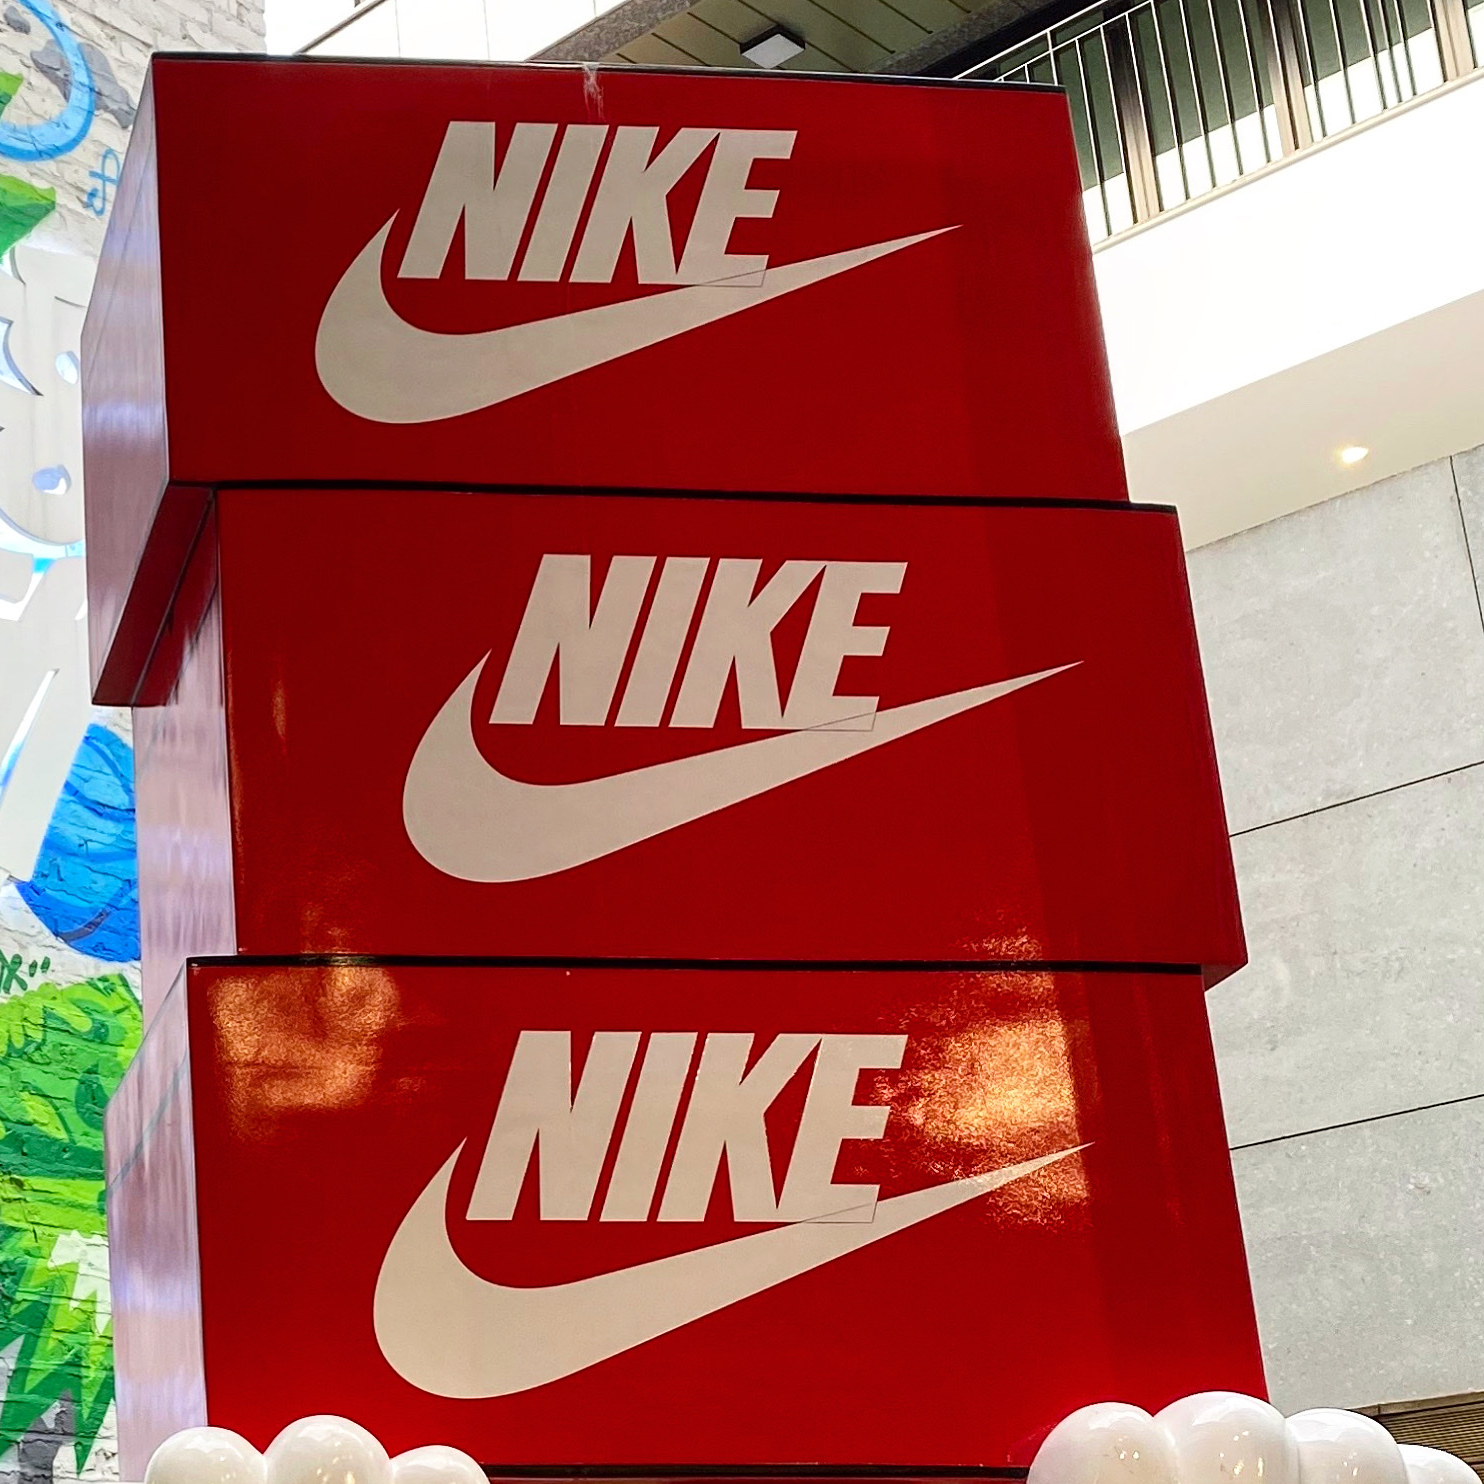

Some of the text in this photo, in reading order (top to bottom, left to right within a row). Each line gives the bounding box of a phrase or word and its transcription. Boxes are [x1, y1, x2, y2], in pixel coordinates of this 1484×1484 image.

[397, 120, 799, 288] NIKE
[488, 553, 908, 732] NIKE
[465, 1029, 909, 1224] NIKE
